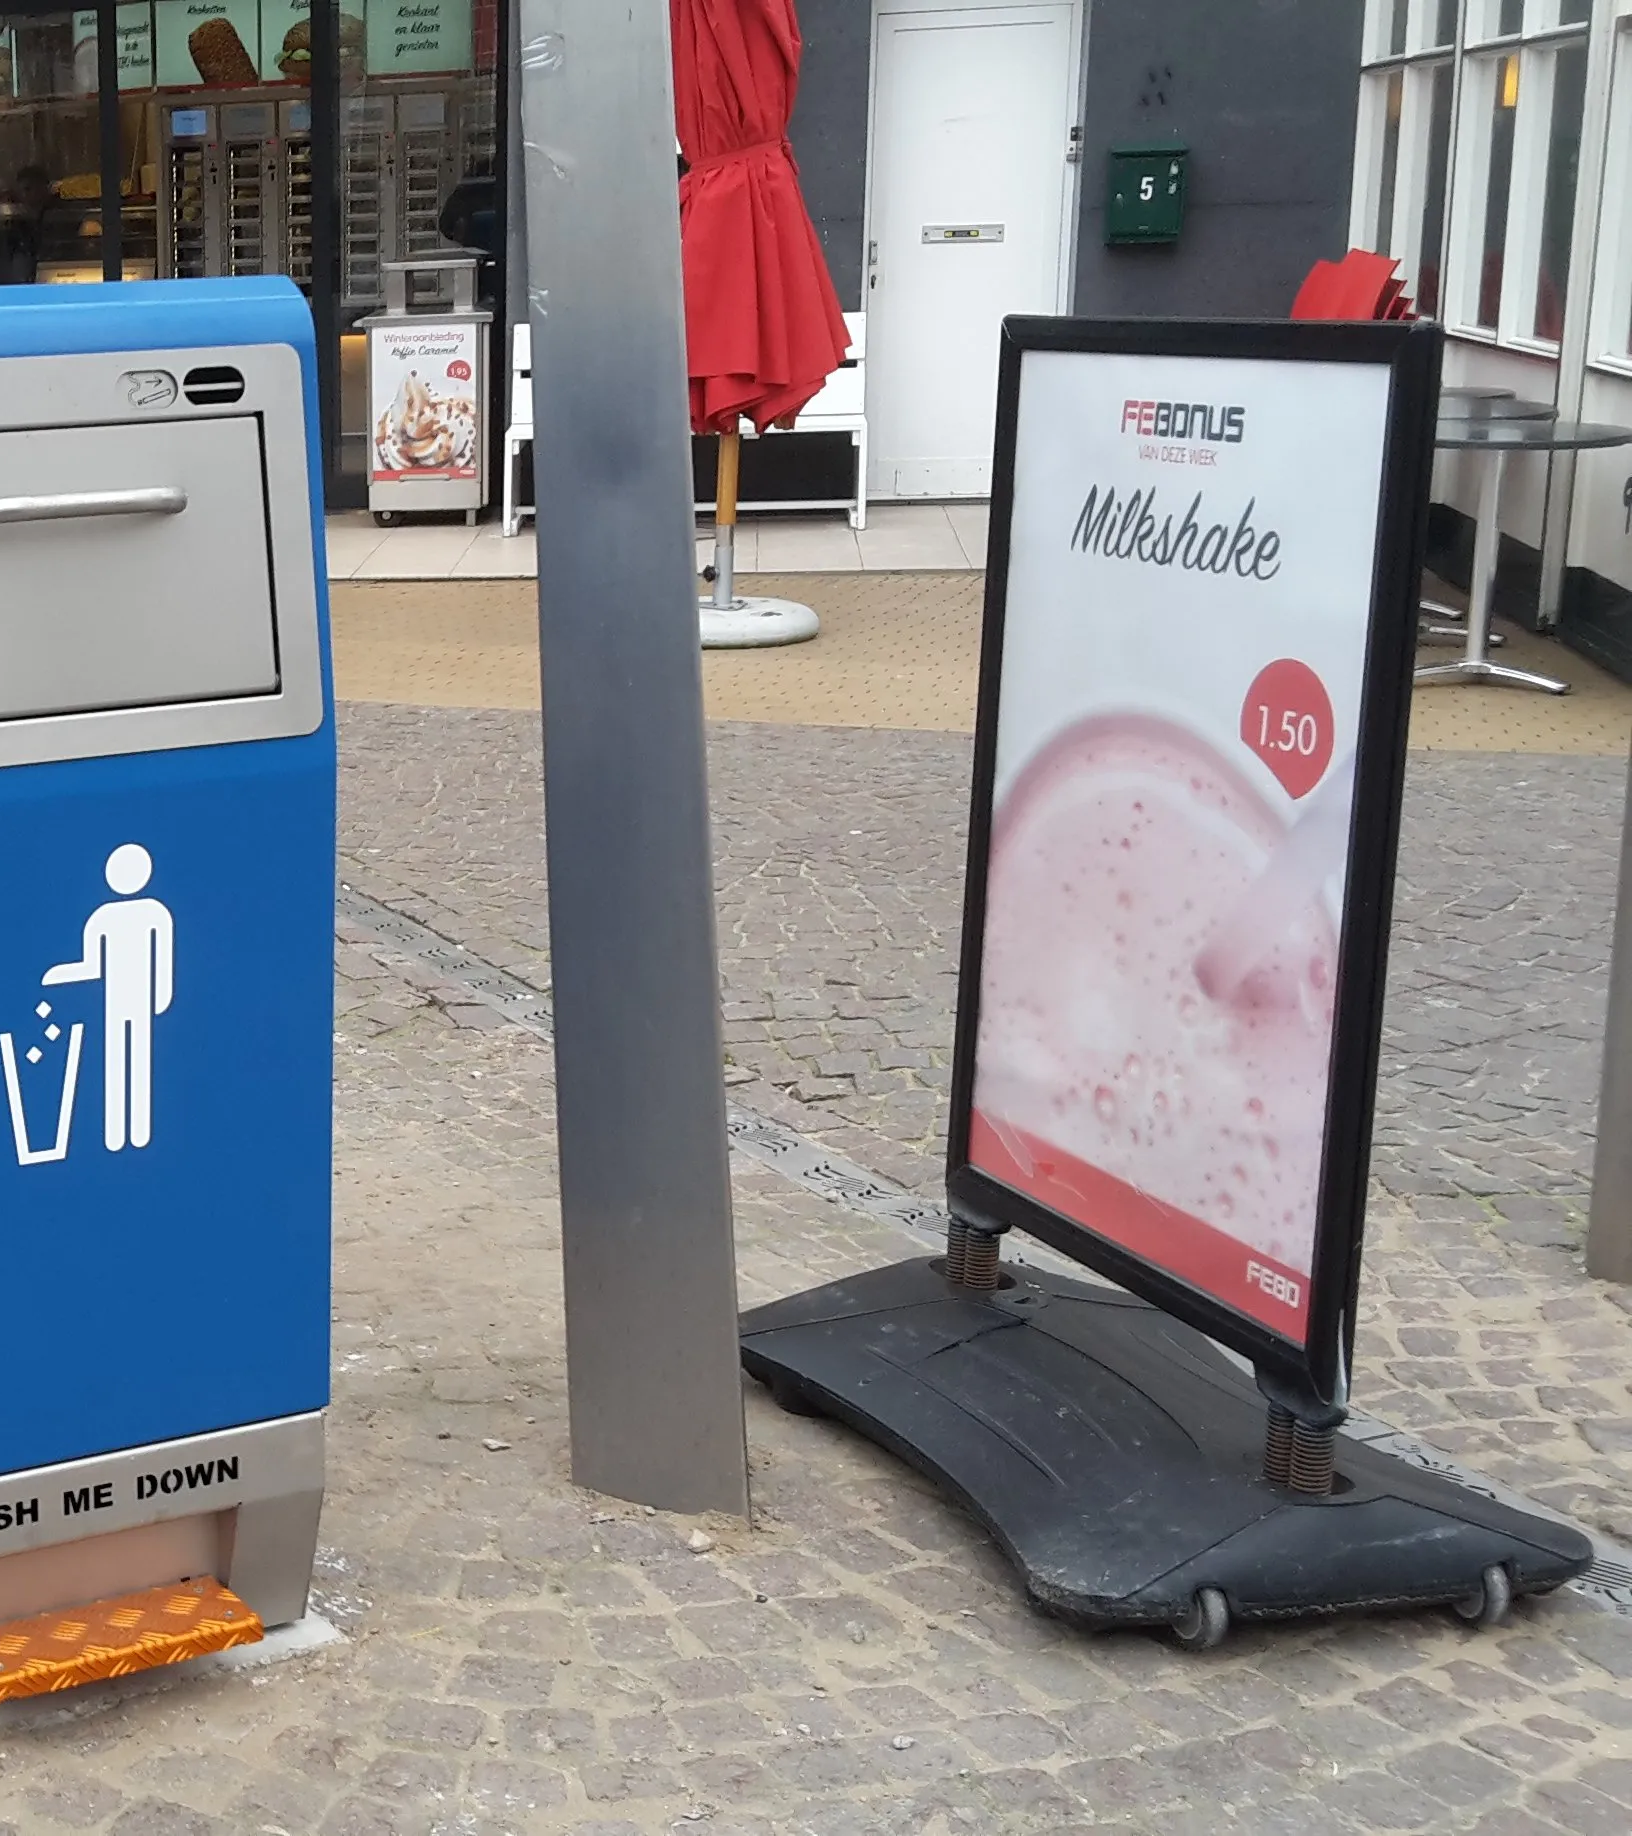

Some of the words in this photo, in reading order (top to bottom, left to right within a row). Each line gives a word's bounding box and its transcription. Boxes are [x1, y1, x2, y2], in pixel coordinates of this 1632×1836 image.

[1139, 176, 1154, 201] 5
[1121, 399, 1246, 444] FEBONUS
[1138, 445, 1159, 461] VAN
[1161, 446, 1187, 464] DEZE
[1189, 449, 1218, 466] WEEK
[1070, 483, 1282, 581] Milkshake
[1258, 704, 1317, 756] 1.50
[1246, 1259, 1301, 1309] FEBO
[63, 1482, 113, 1516] ME
[136, 1456, 239, 1500] DOWN
